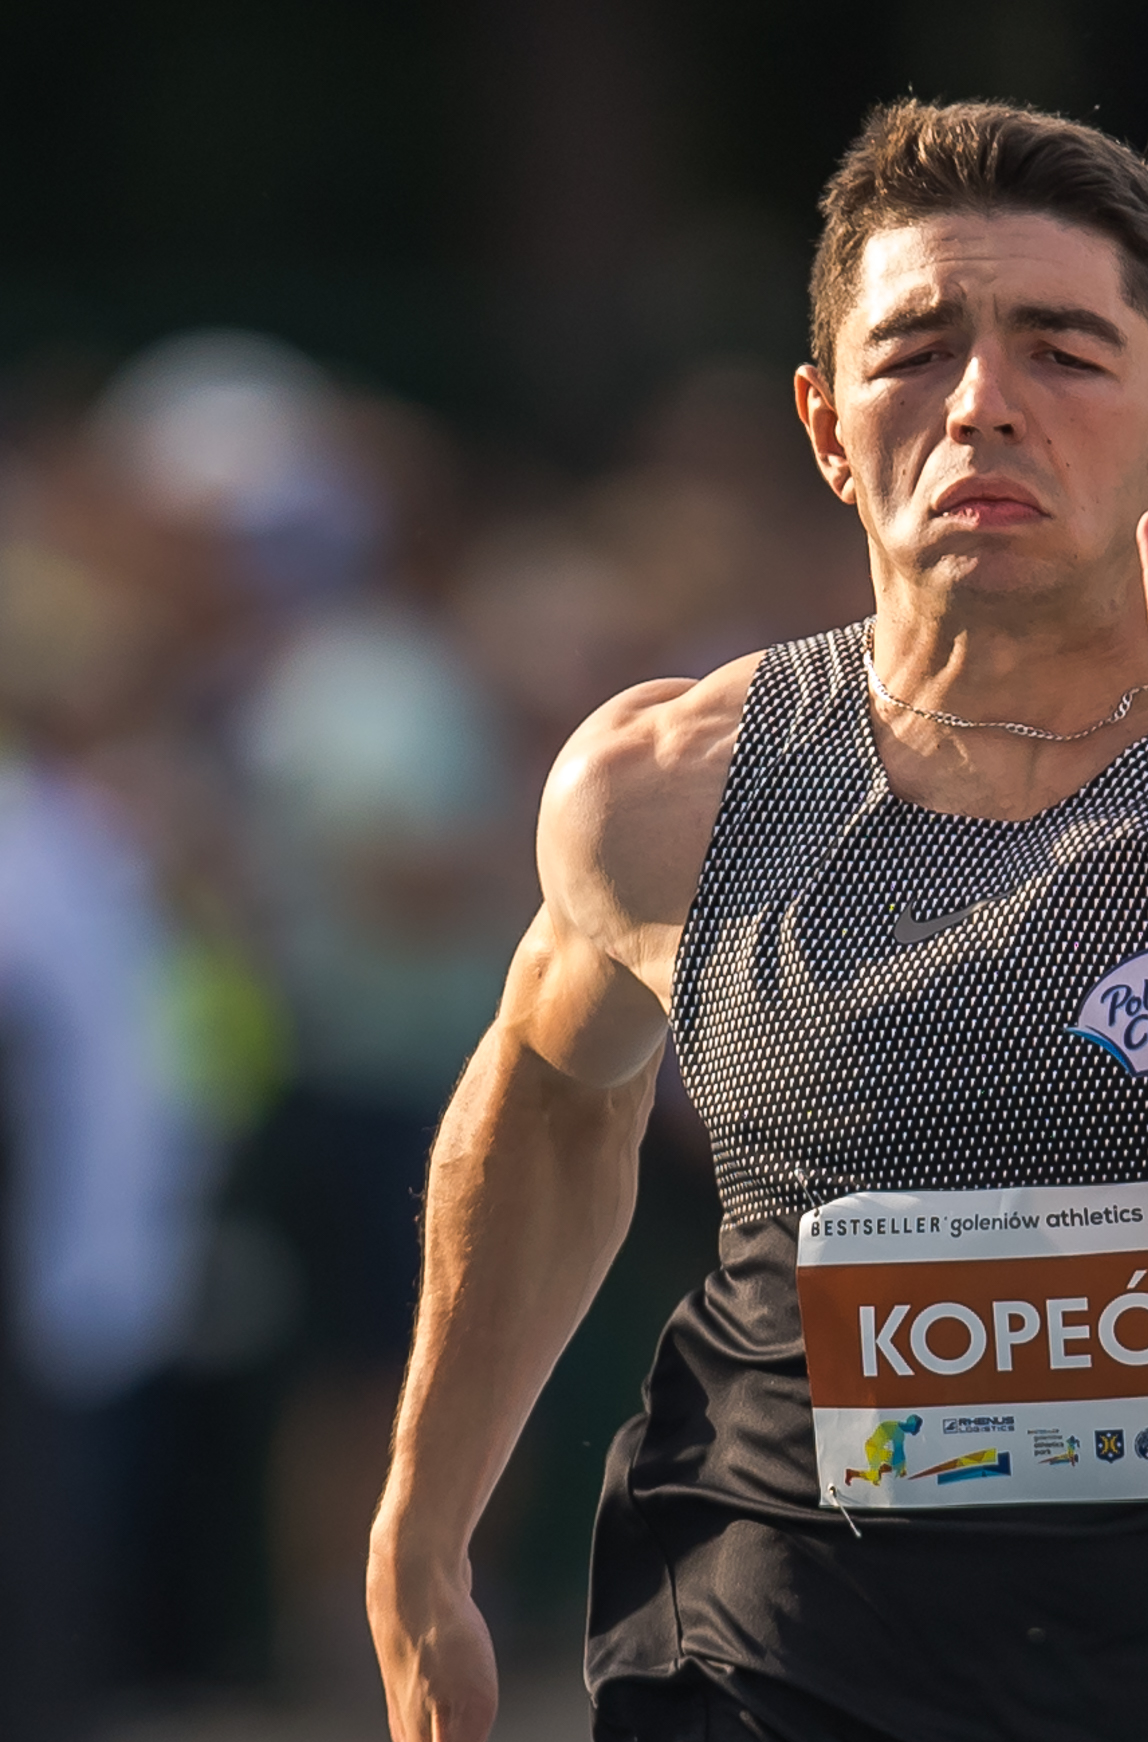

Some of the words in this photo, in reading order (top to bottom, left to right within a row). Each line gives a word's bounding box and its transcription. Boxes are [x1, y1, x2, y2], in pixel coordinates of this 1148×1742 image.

[810, 1216, 940, 1237] BESTSELLER
[950, 1211, 1040, 1238] goleniów
[1046, 1204, 1143, 1228] athletics
[958, 1416, 1015, 1426] RHENUS
